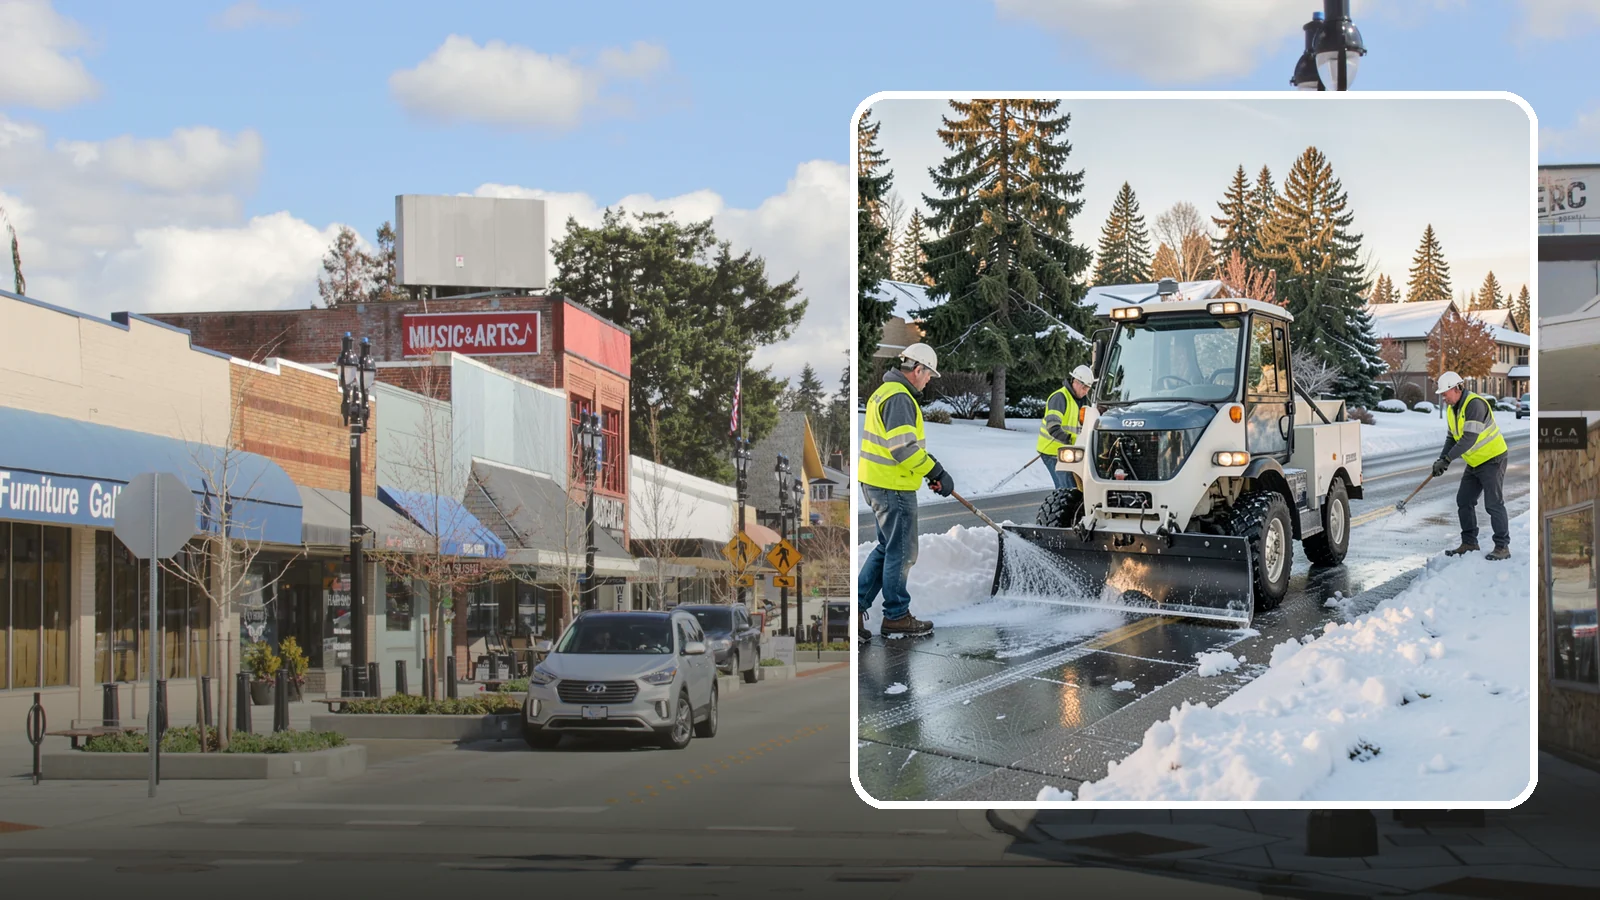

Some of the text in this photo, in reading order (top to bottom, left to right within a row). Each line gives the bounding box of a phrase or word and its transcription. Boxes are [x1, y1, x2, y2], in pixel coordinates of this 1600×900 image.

[0, 471, 122, 519] Furniture Gal
[453, 563, 479, 574] SUSHI
